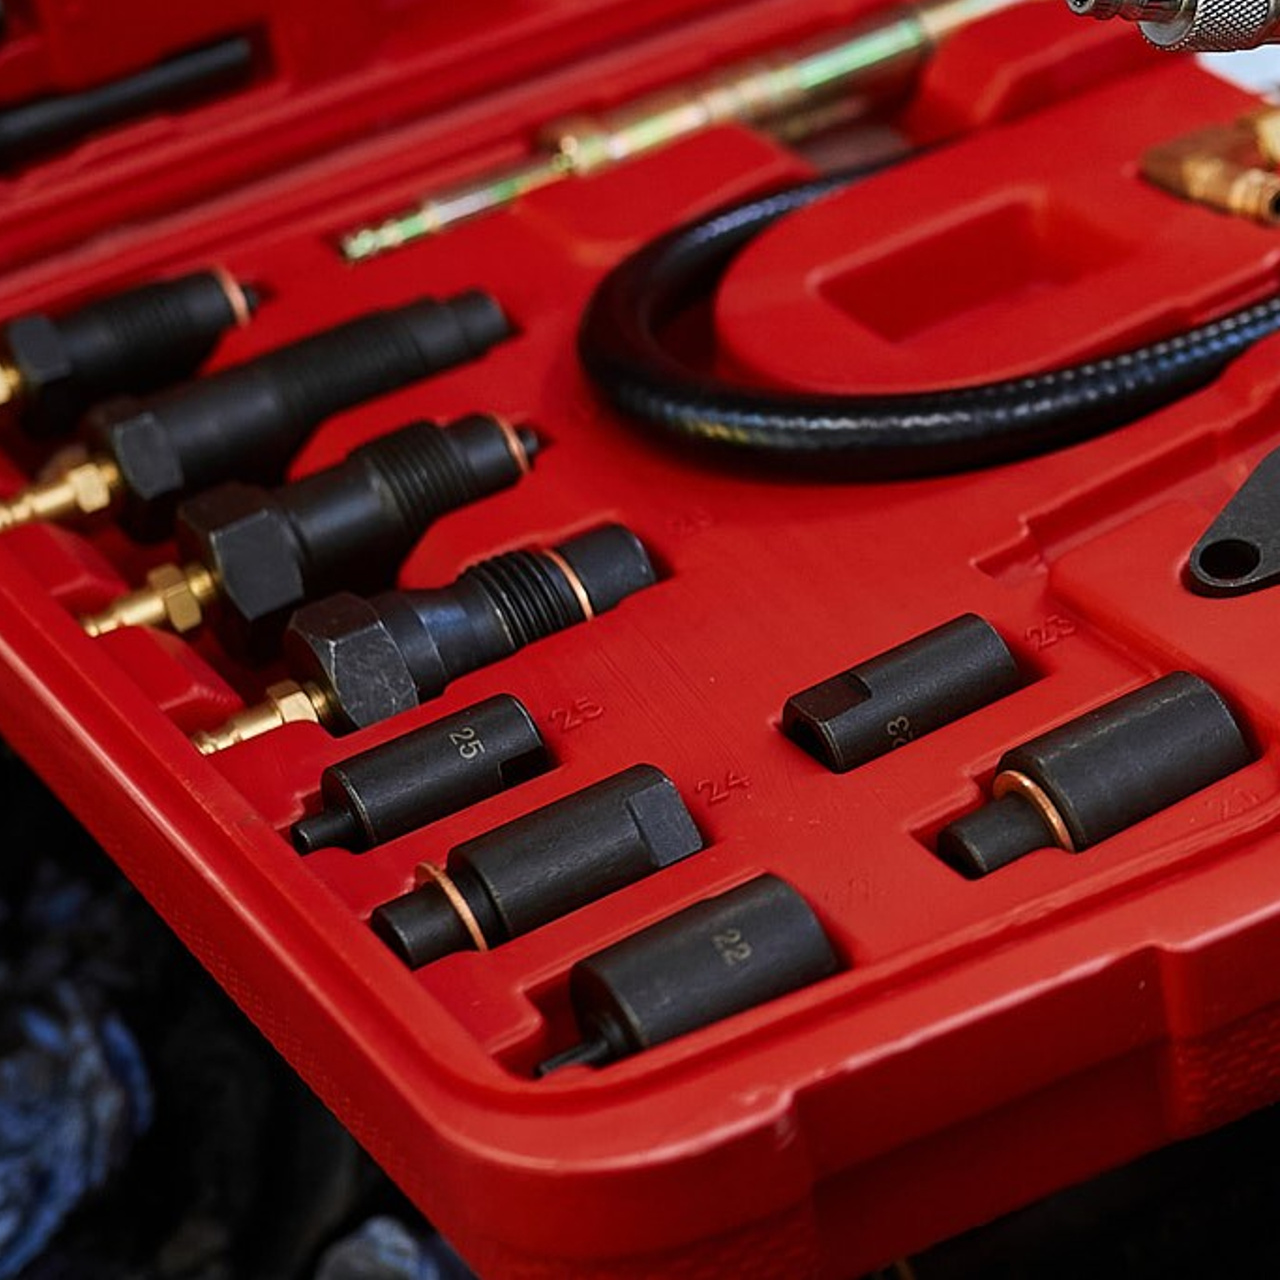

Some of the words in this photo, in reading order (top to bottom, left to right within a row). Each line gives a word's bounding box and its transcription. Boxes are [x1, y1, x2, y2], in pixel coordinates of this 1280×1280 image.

[1023, 614, 1077, 652] 23
[548, 696, 605, 732] 25
[448, 726, 487, 760] 25
[694, 770, 753, 808] 24
[711, 927, 753, 967] 22
